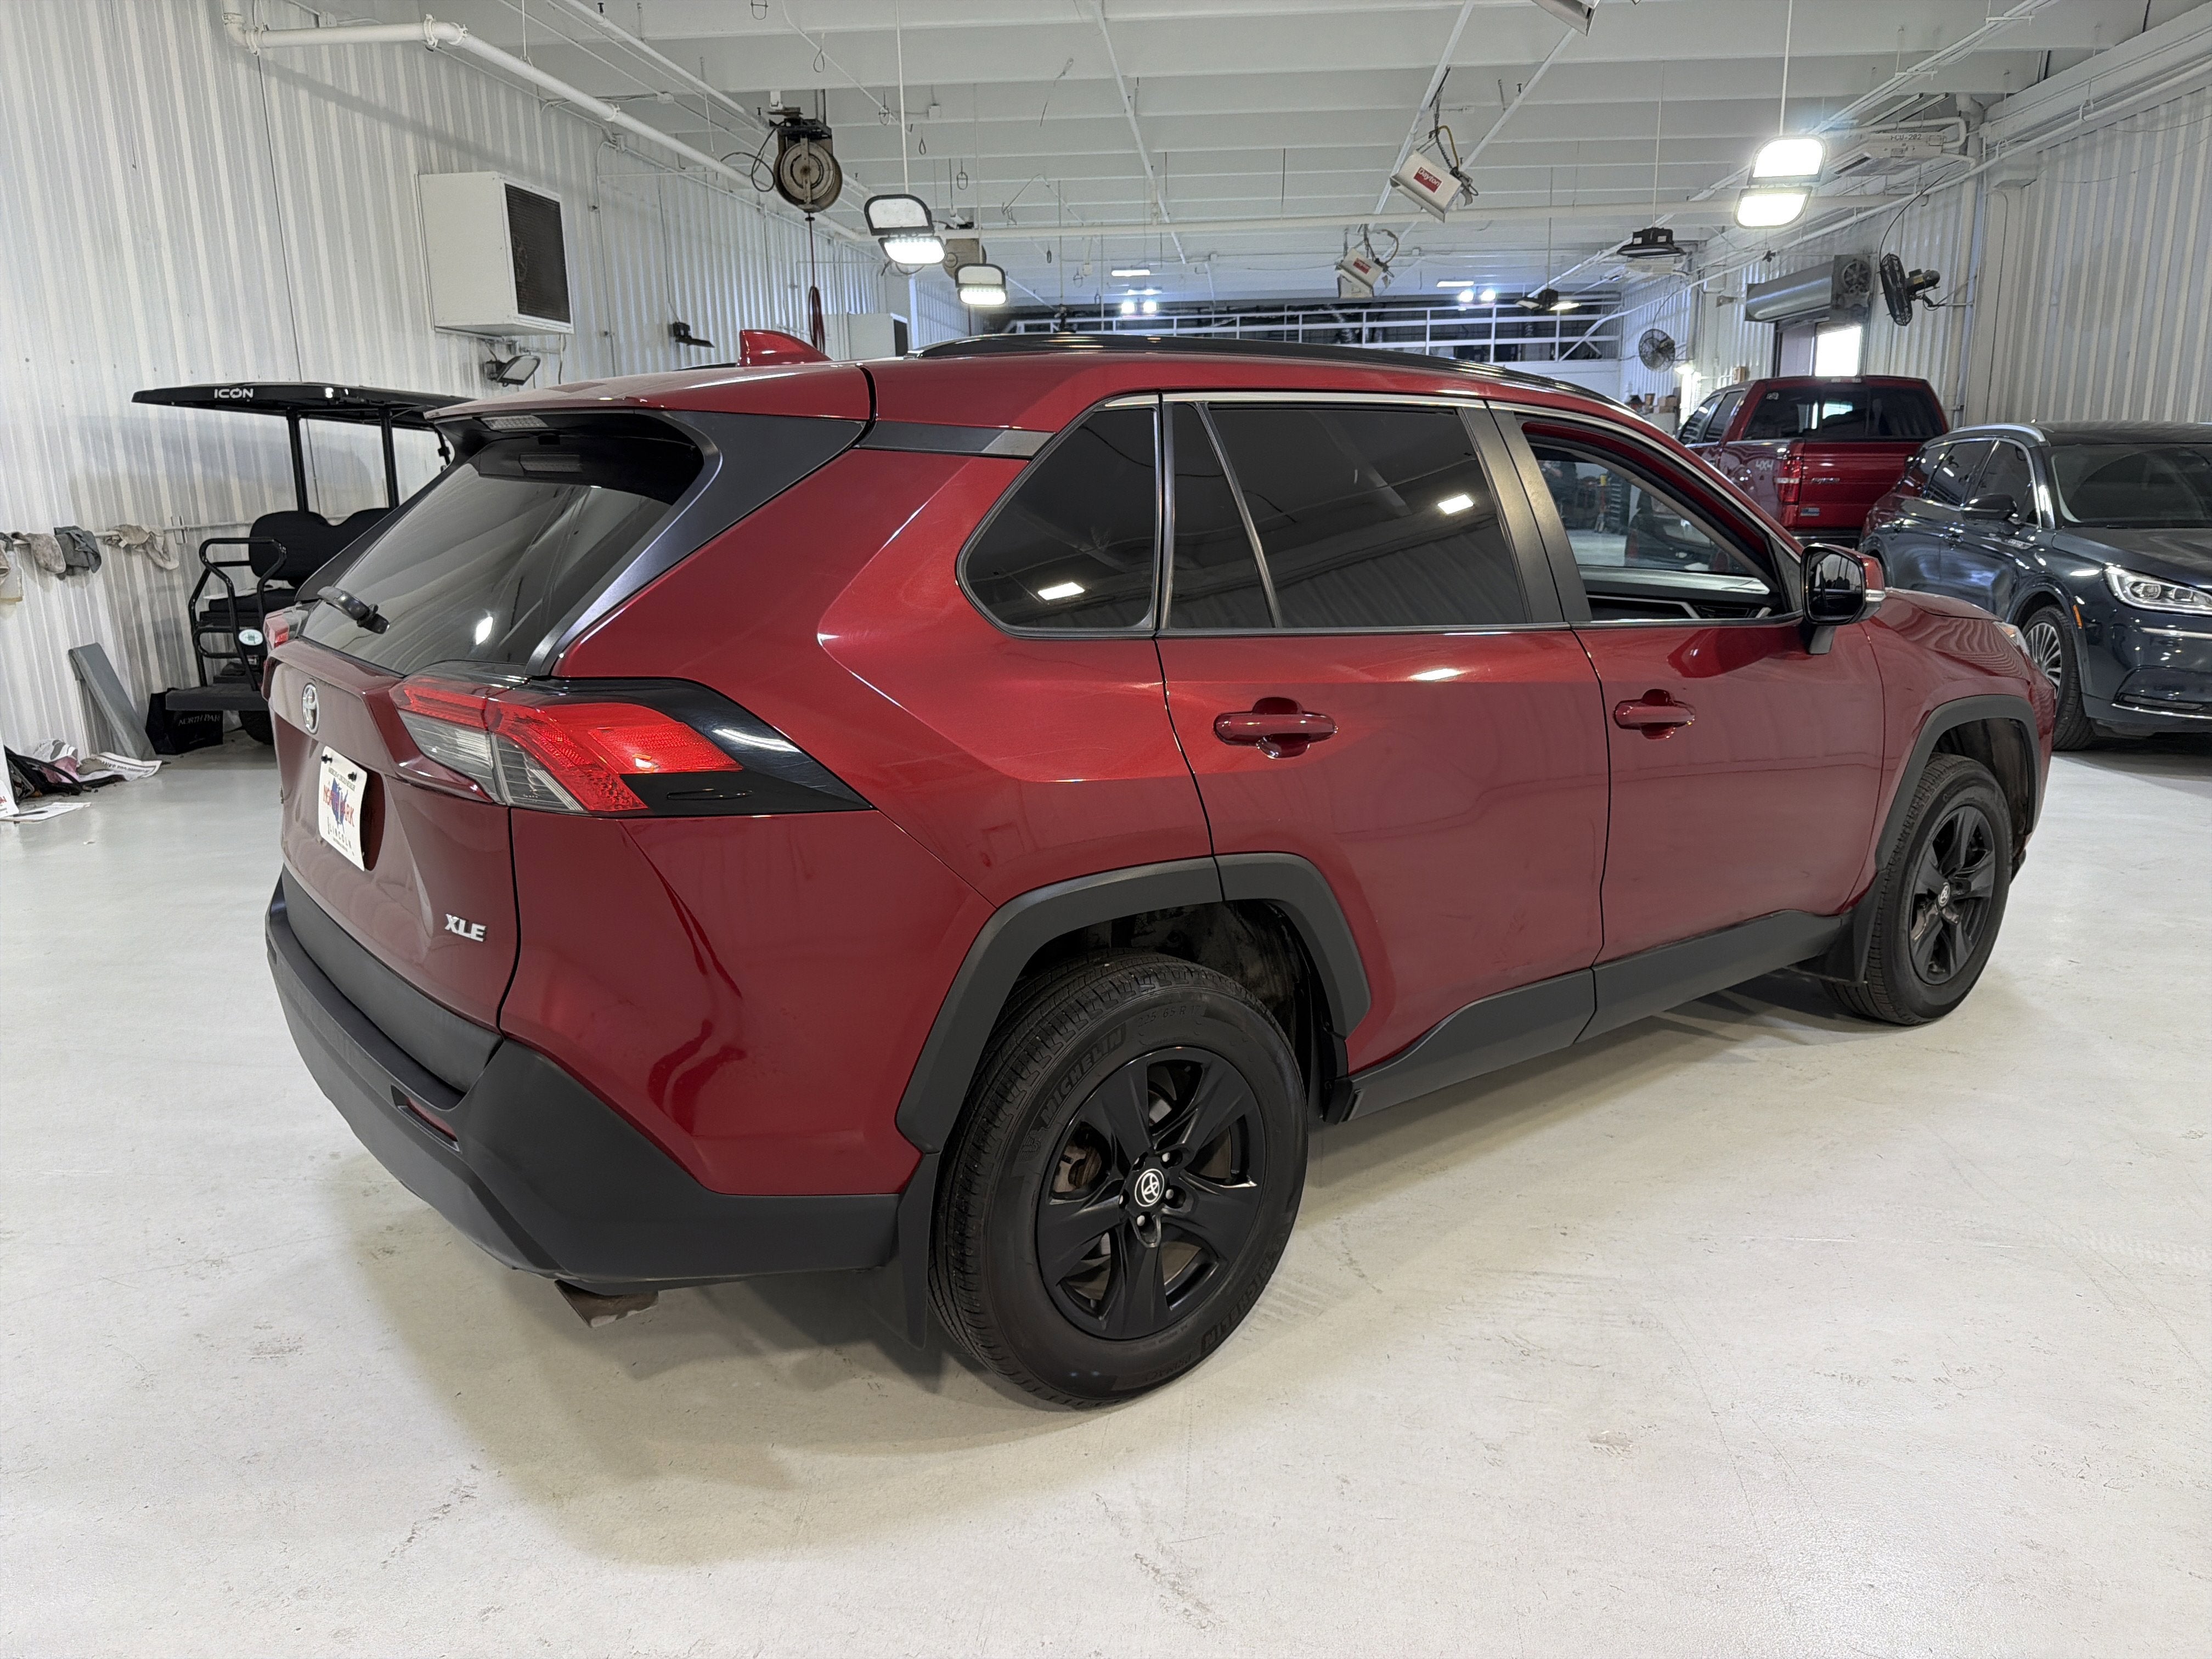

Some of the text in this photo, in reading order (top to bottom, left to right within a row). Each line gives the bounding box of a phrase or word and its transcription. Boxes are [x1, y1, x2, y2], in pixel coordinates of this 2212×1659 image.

[1418, 168, 1441, 187] Dayton
[214, 388, 253, 399] ICON
[330, 823, 352, 849] LINCOLN
[444, 913, 487, 942] XLE
[1041, 1028, 1124, 1125] MICHELIN
[1203, 1257, 1272, 1351] MICHELIN
